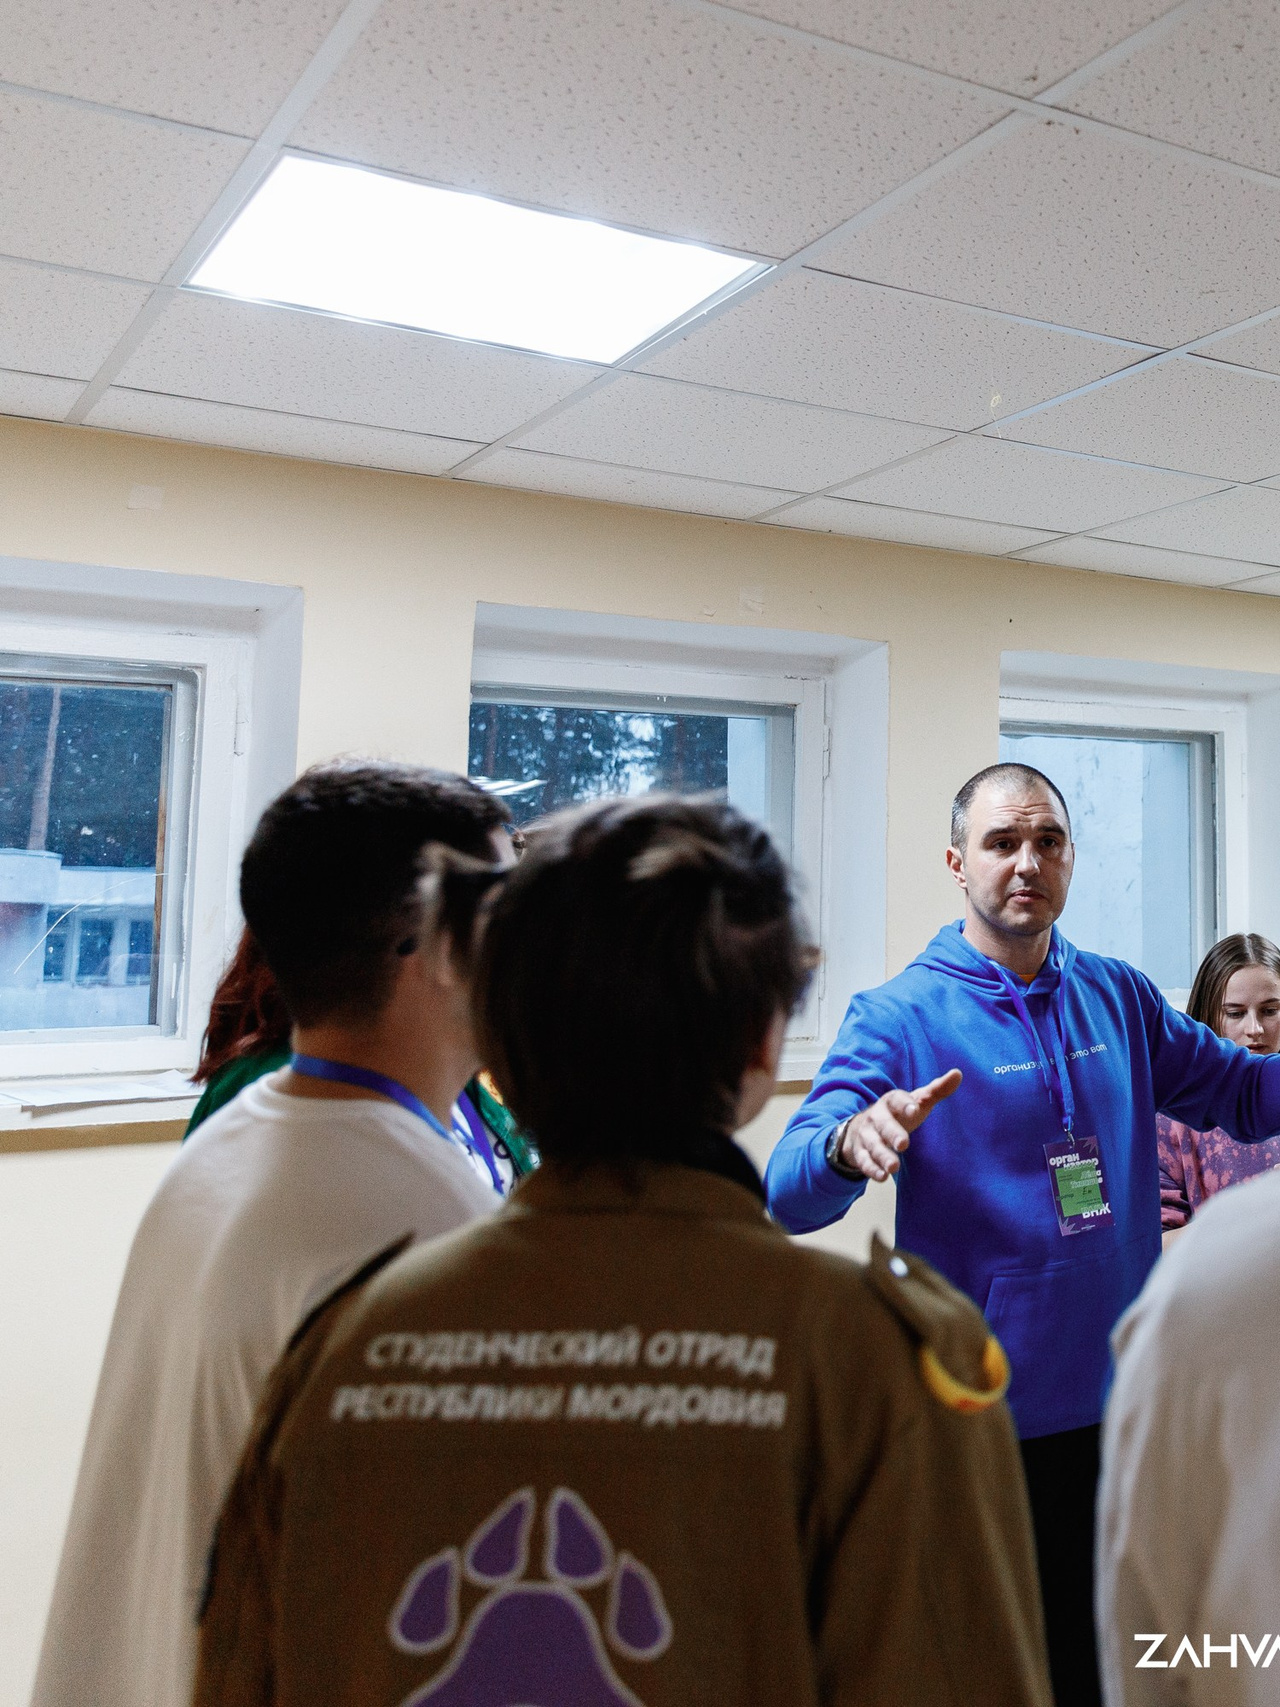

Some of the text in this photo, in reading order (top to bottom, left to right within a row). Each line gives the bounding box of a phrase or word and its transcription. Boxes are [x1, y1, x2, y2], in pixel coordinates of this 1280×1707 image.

[366, 1326, 777, 1380] СТУДЕНЧЕСКИЙ ОТРЯД
[330, 1383, 788, 1430] РЕСПУБЛИКИ МОРДОВИЯ
